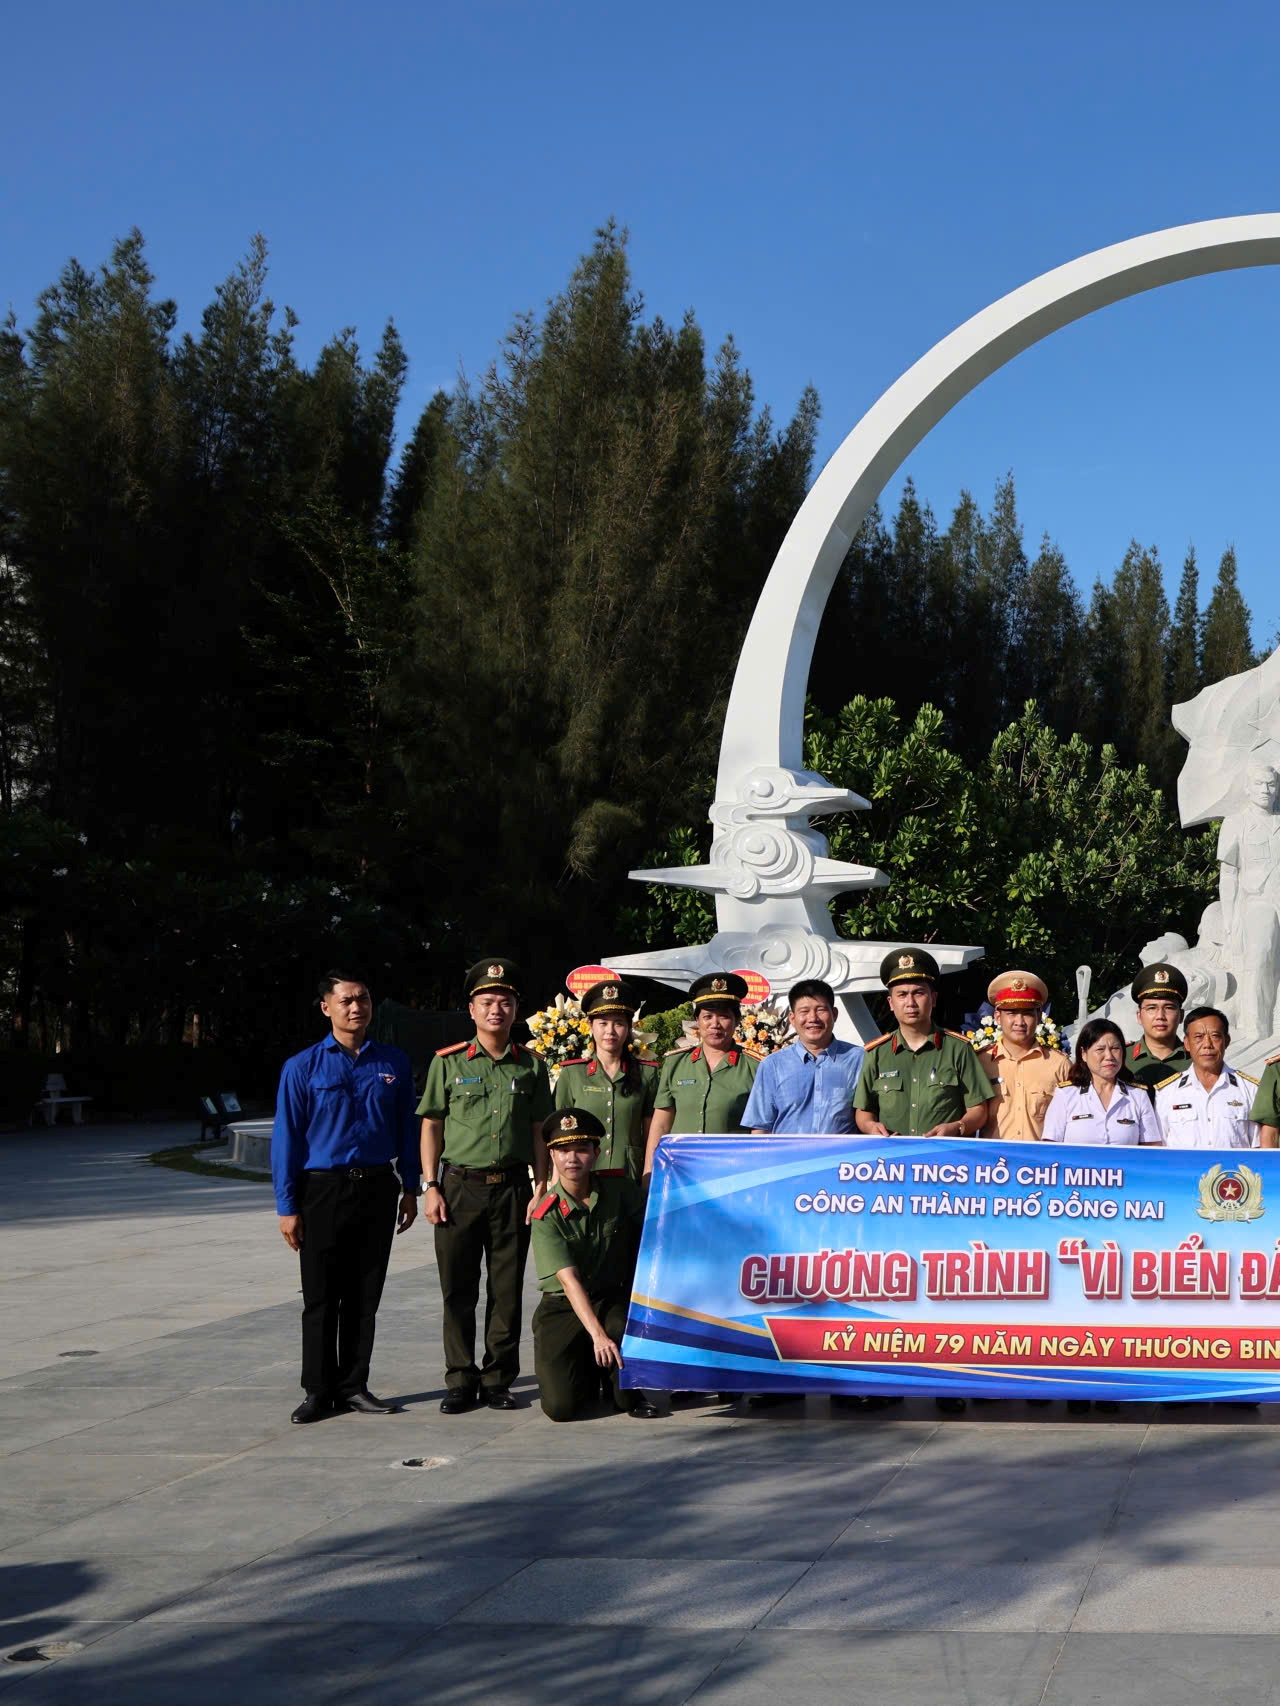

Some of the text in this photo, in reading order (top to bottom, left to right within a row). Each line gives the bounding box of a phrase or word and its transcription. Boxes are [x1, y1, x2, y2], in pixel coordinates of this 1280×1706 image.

[838, 1156, 1123, 1187] ĐOÀN TNCS HỒ CHÍ MINH
[794, 1189, 1165, 1219] CÔNG AN THÀNH PHỐ ĐỒNG NAI
[739, 1247, 918, 1304] CHƯƠNG
[921, 1240, 1052, 1301] TRÌNH
[1131, 1233, 1231, 1300] BIỂN
[822, 1325, 856, 1351] KỶ
[863, 1327, 925, 1358] NIỆM
[934, 1334, 965, 1354] 79
[972, 1330, 1032, 1356] NĂM
[1040, 1332, 1115, 1358] NGÀY
[1121, 1335, 1231, 1360] THƯƠNG
